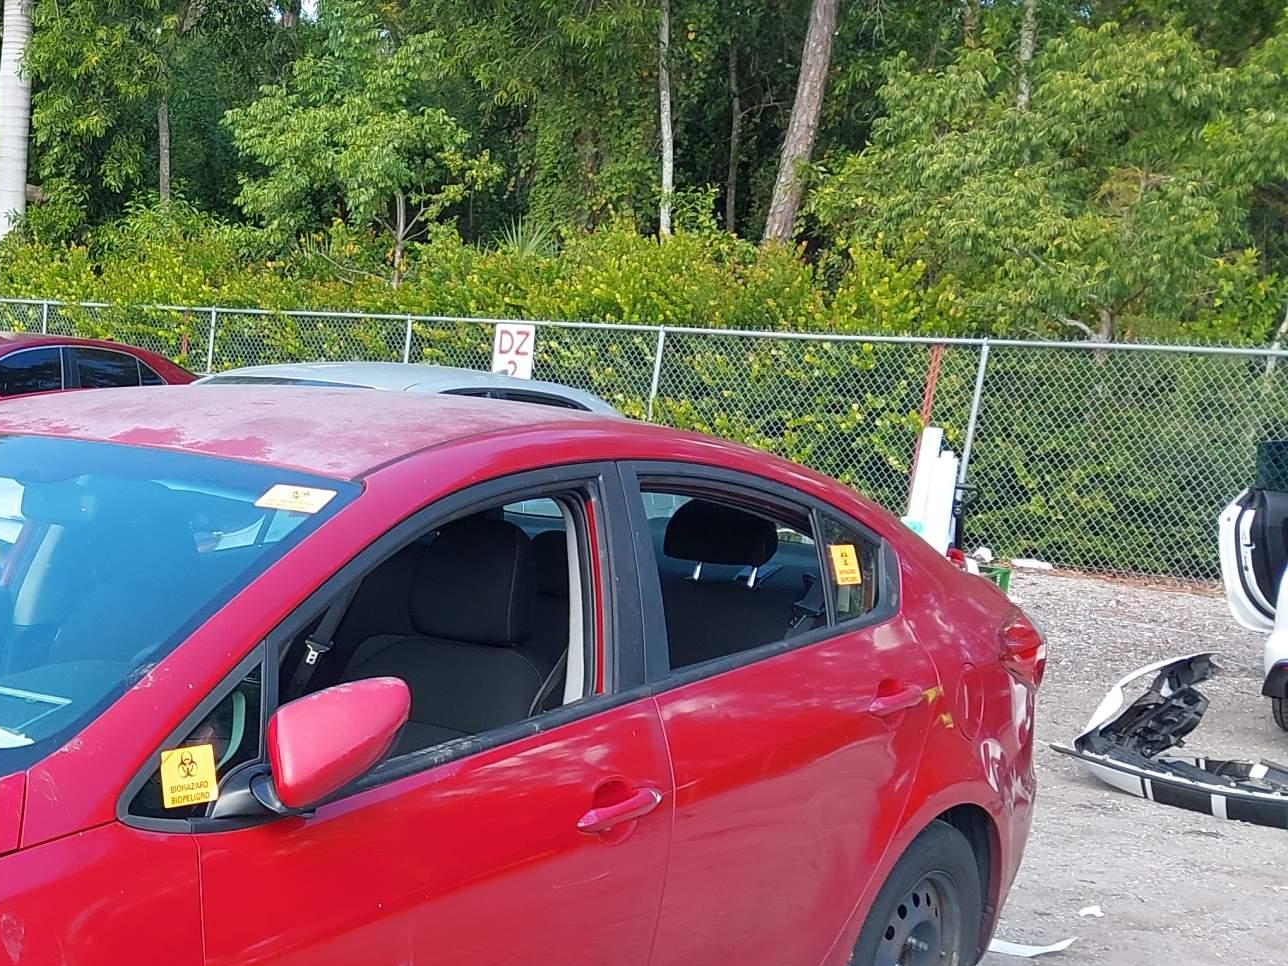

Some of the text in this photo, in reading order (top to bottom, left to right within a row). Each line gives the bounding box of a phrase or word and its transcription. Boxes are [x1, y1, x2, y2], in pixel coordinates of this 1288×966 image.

[498, 330, 531, 356] DZ
[170, 781, 209, 794] BIOHAZARD
[171, 792, 210, 805] BIOPELIGRO
